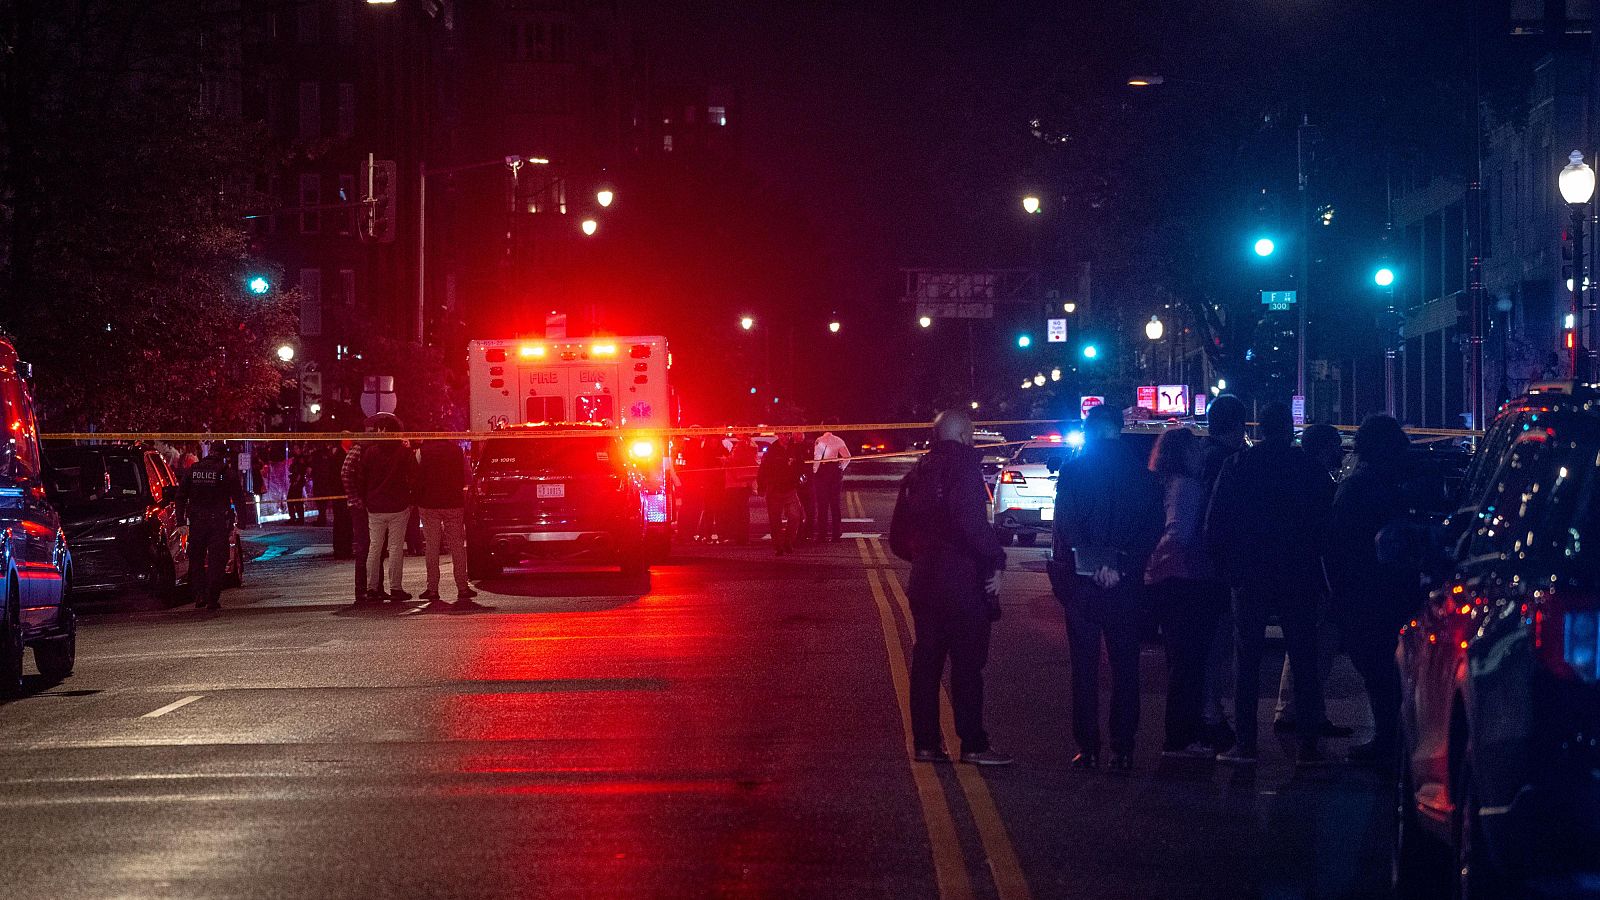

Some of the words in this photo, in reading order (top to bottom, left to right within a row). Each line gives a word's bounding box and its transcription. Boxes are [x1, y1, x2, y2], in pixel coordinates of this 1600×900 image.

[1272, 293, 1276, 302] F
[530, 371, 559, 384] FIRE
[580, 370, 606, 383] EMS
